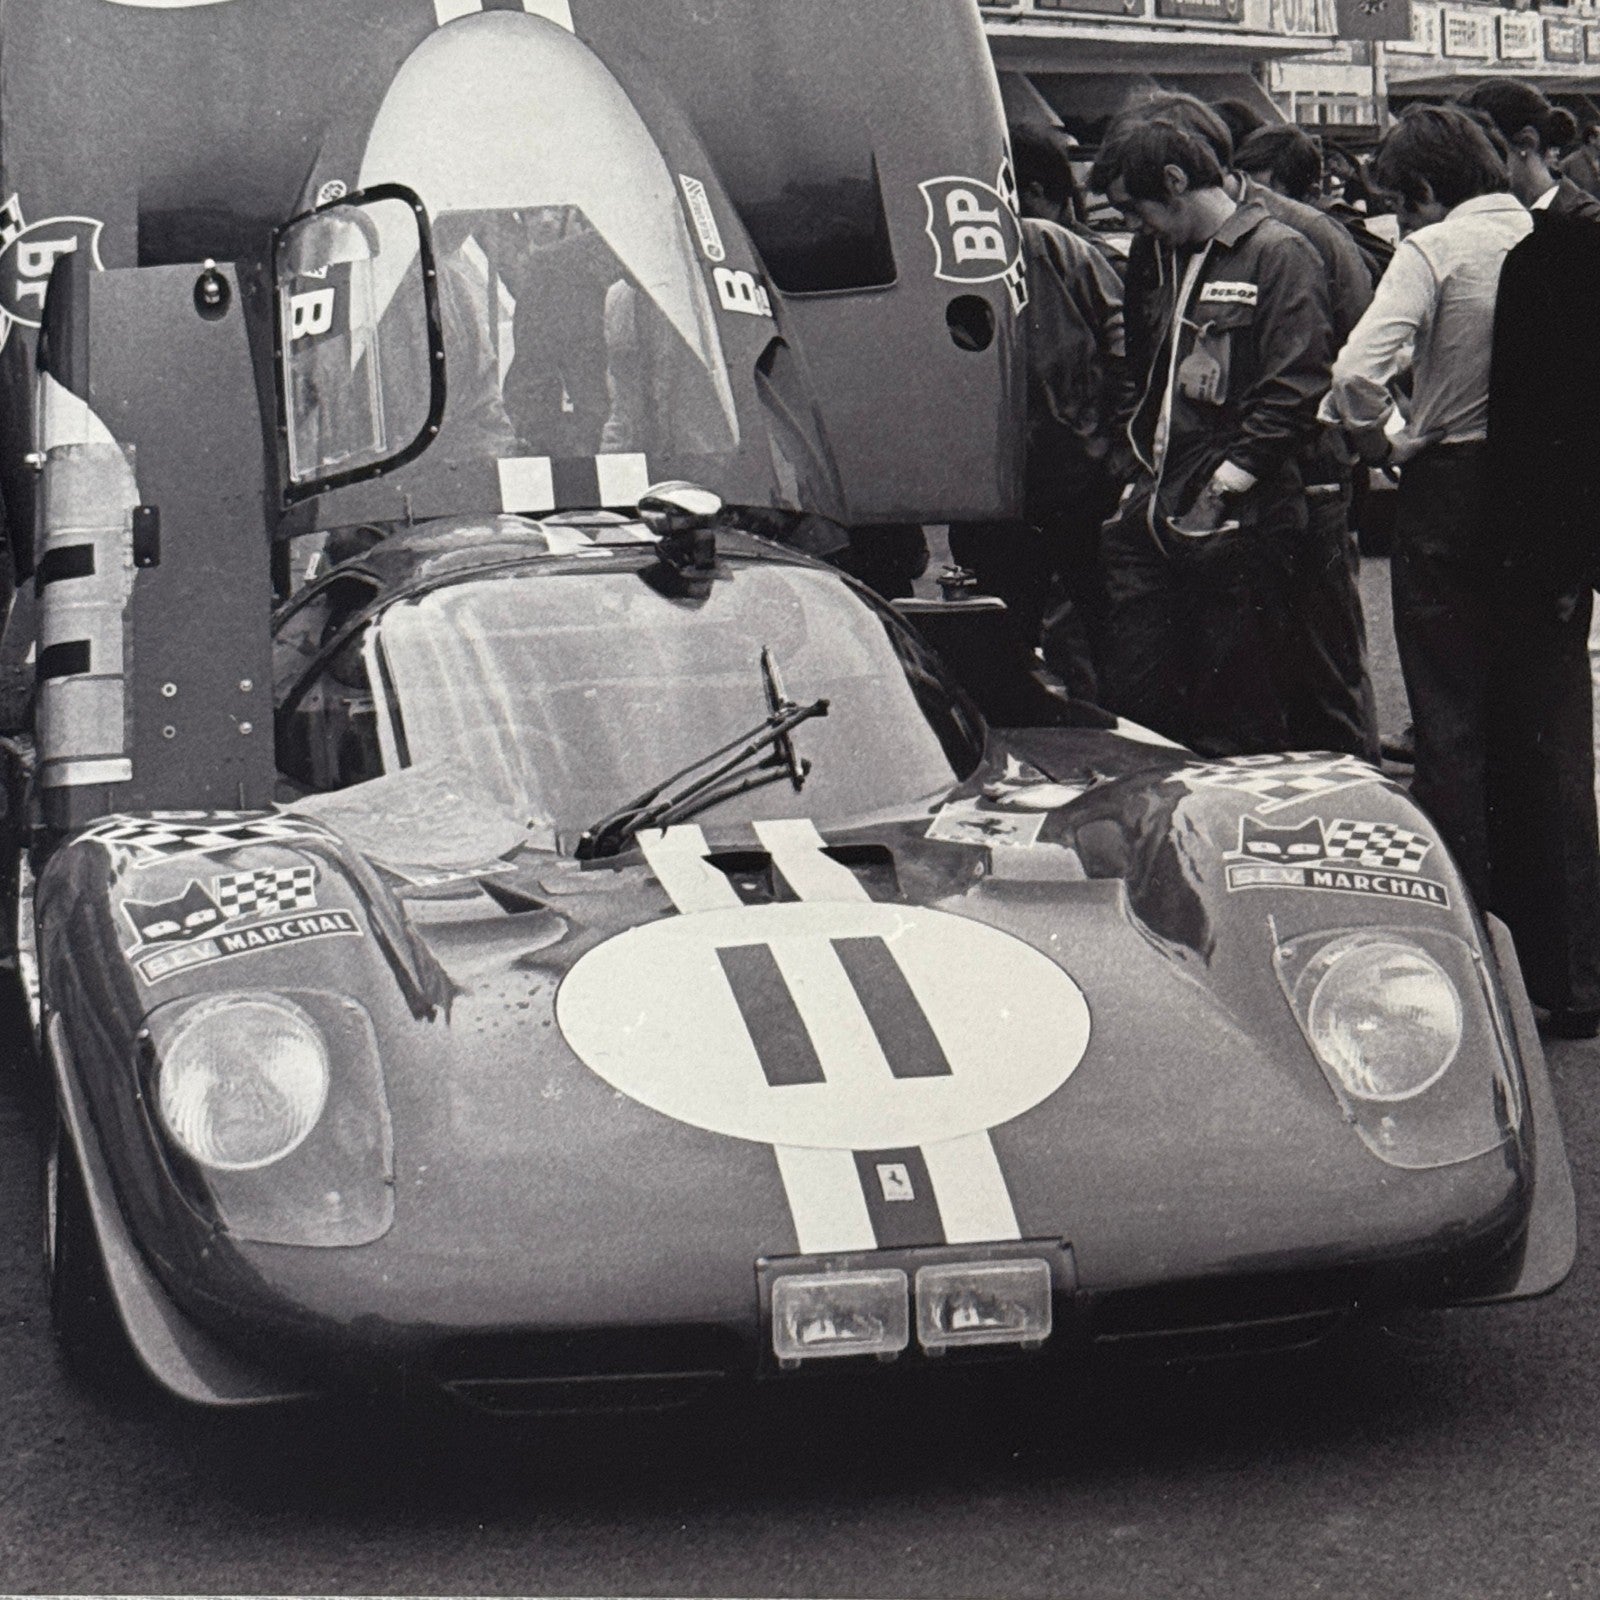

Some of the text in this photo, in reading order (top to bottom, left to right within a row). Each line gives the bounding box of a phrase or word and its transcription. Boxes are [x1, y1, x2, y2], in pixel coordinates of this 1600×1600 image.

[945, 188, 1007, 266] BP
[1313, 870, 1441, 902] MARCHAL
[223, 913, 351, 952] MARCHAL
[715, 935, 953, 1087] 11
